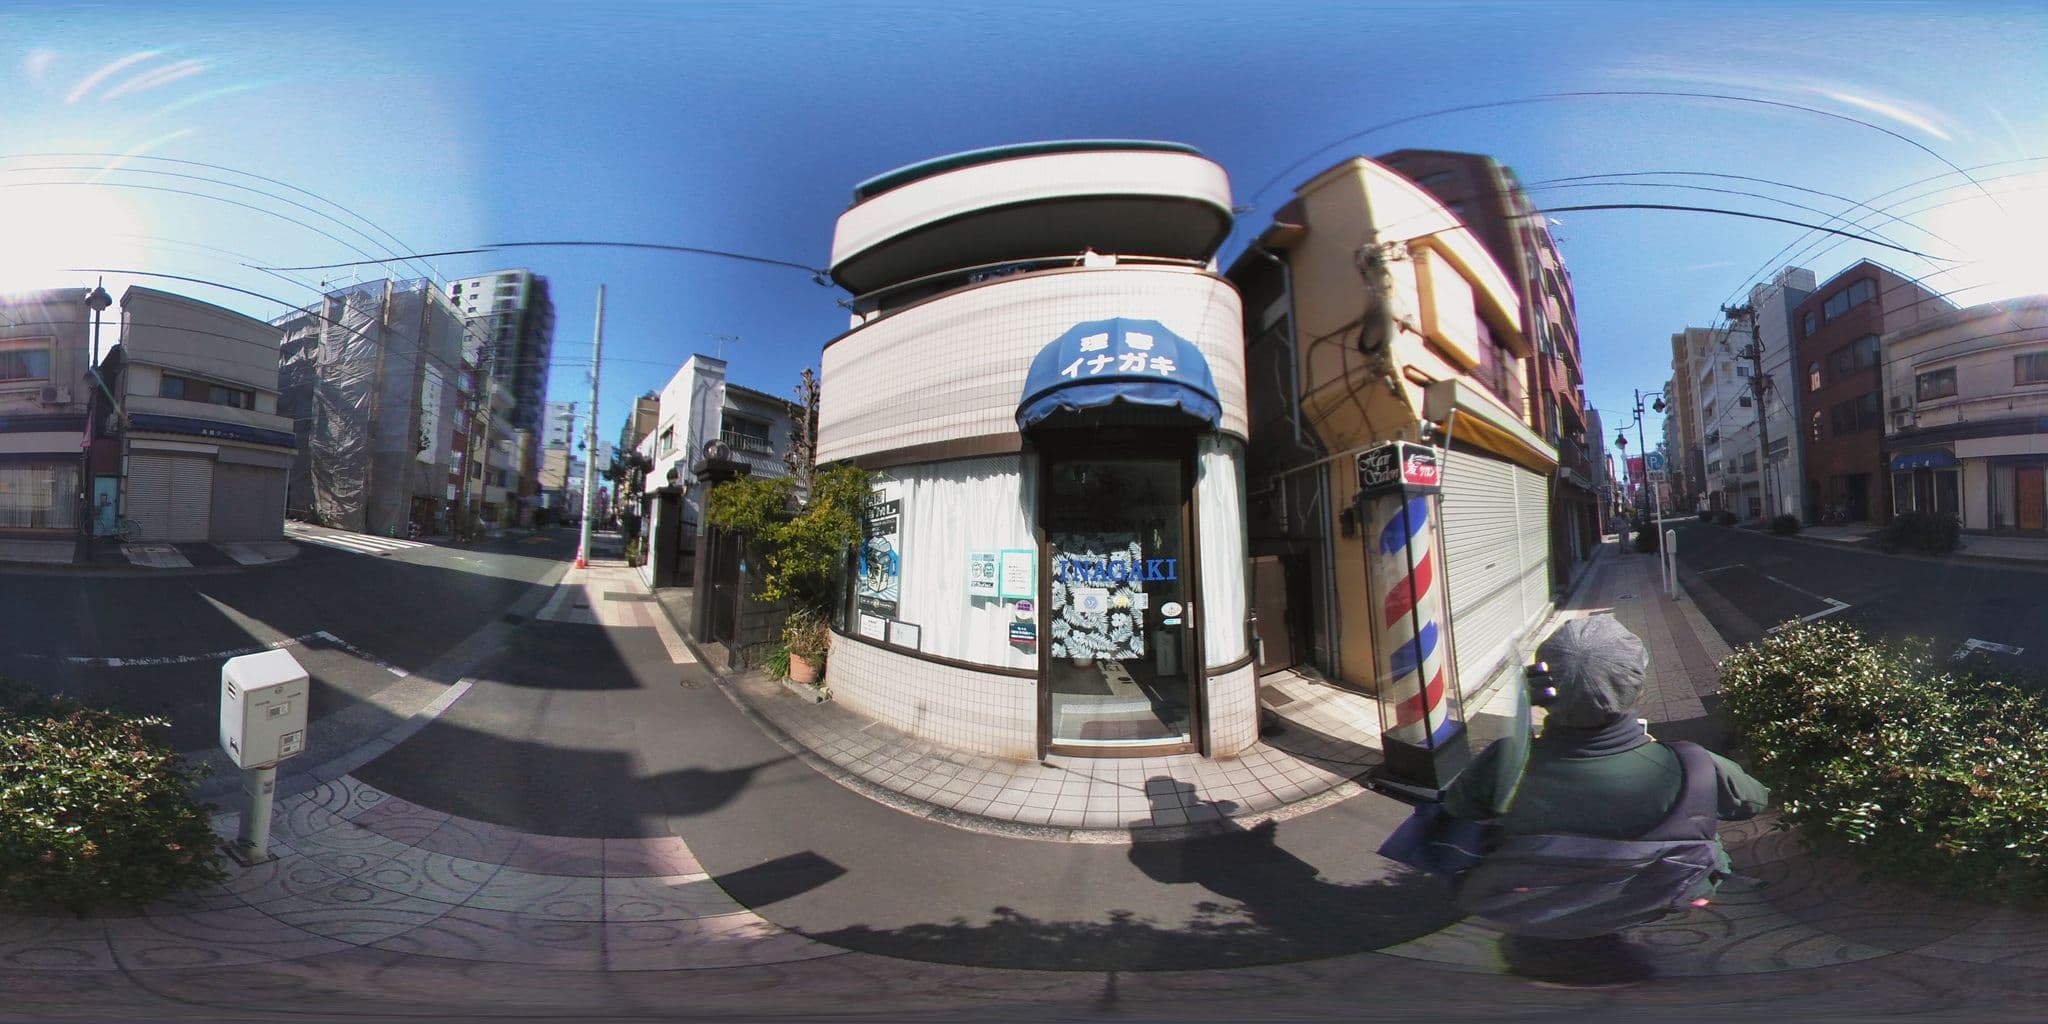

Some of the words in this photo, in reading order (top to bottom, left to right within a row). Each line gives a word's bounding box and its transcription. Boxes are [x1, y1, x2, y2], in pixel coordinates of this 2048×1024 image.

[1061, 352, 1177, 377] イナガキ
[1060, 559, 1177, 581] INAGAKI
